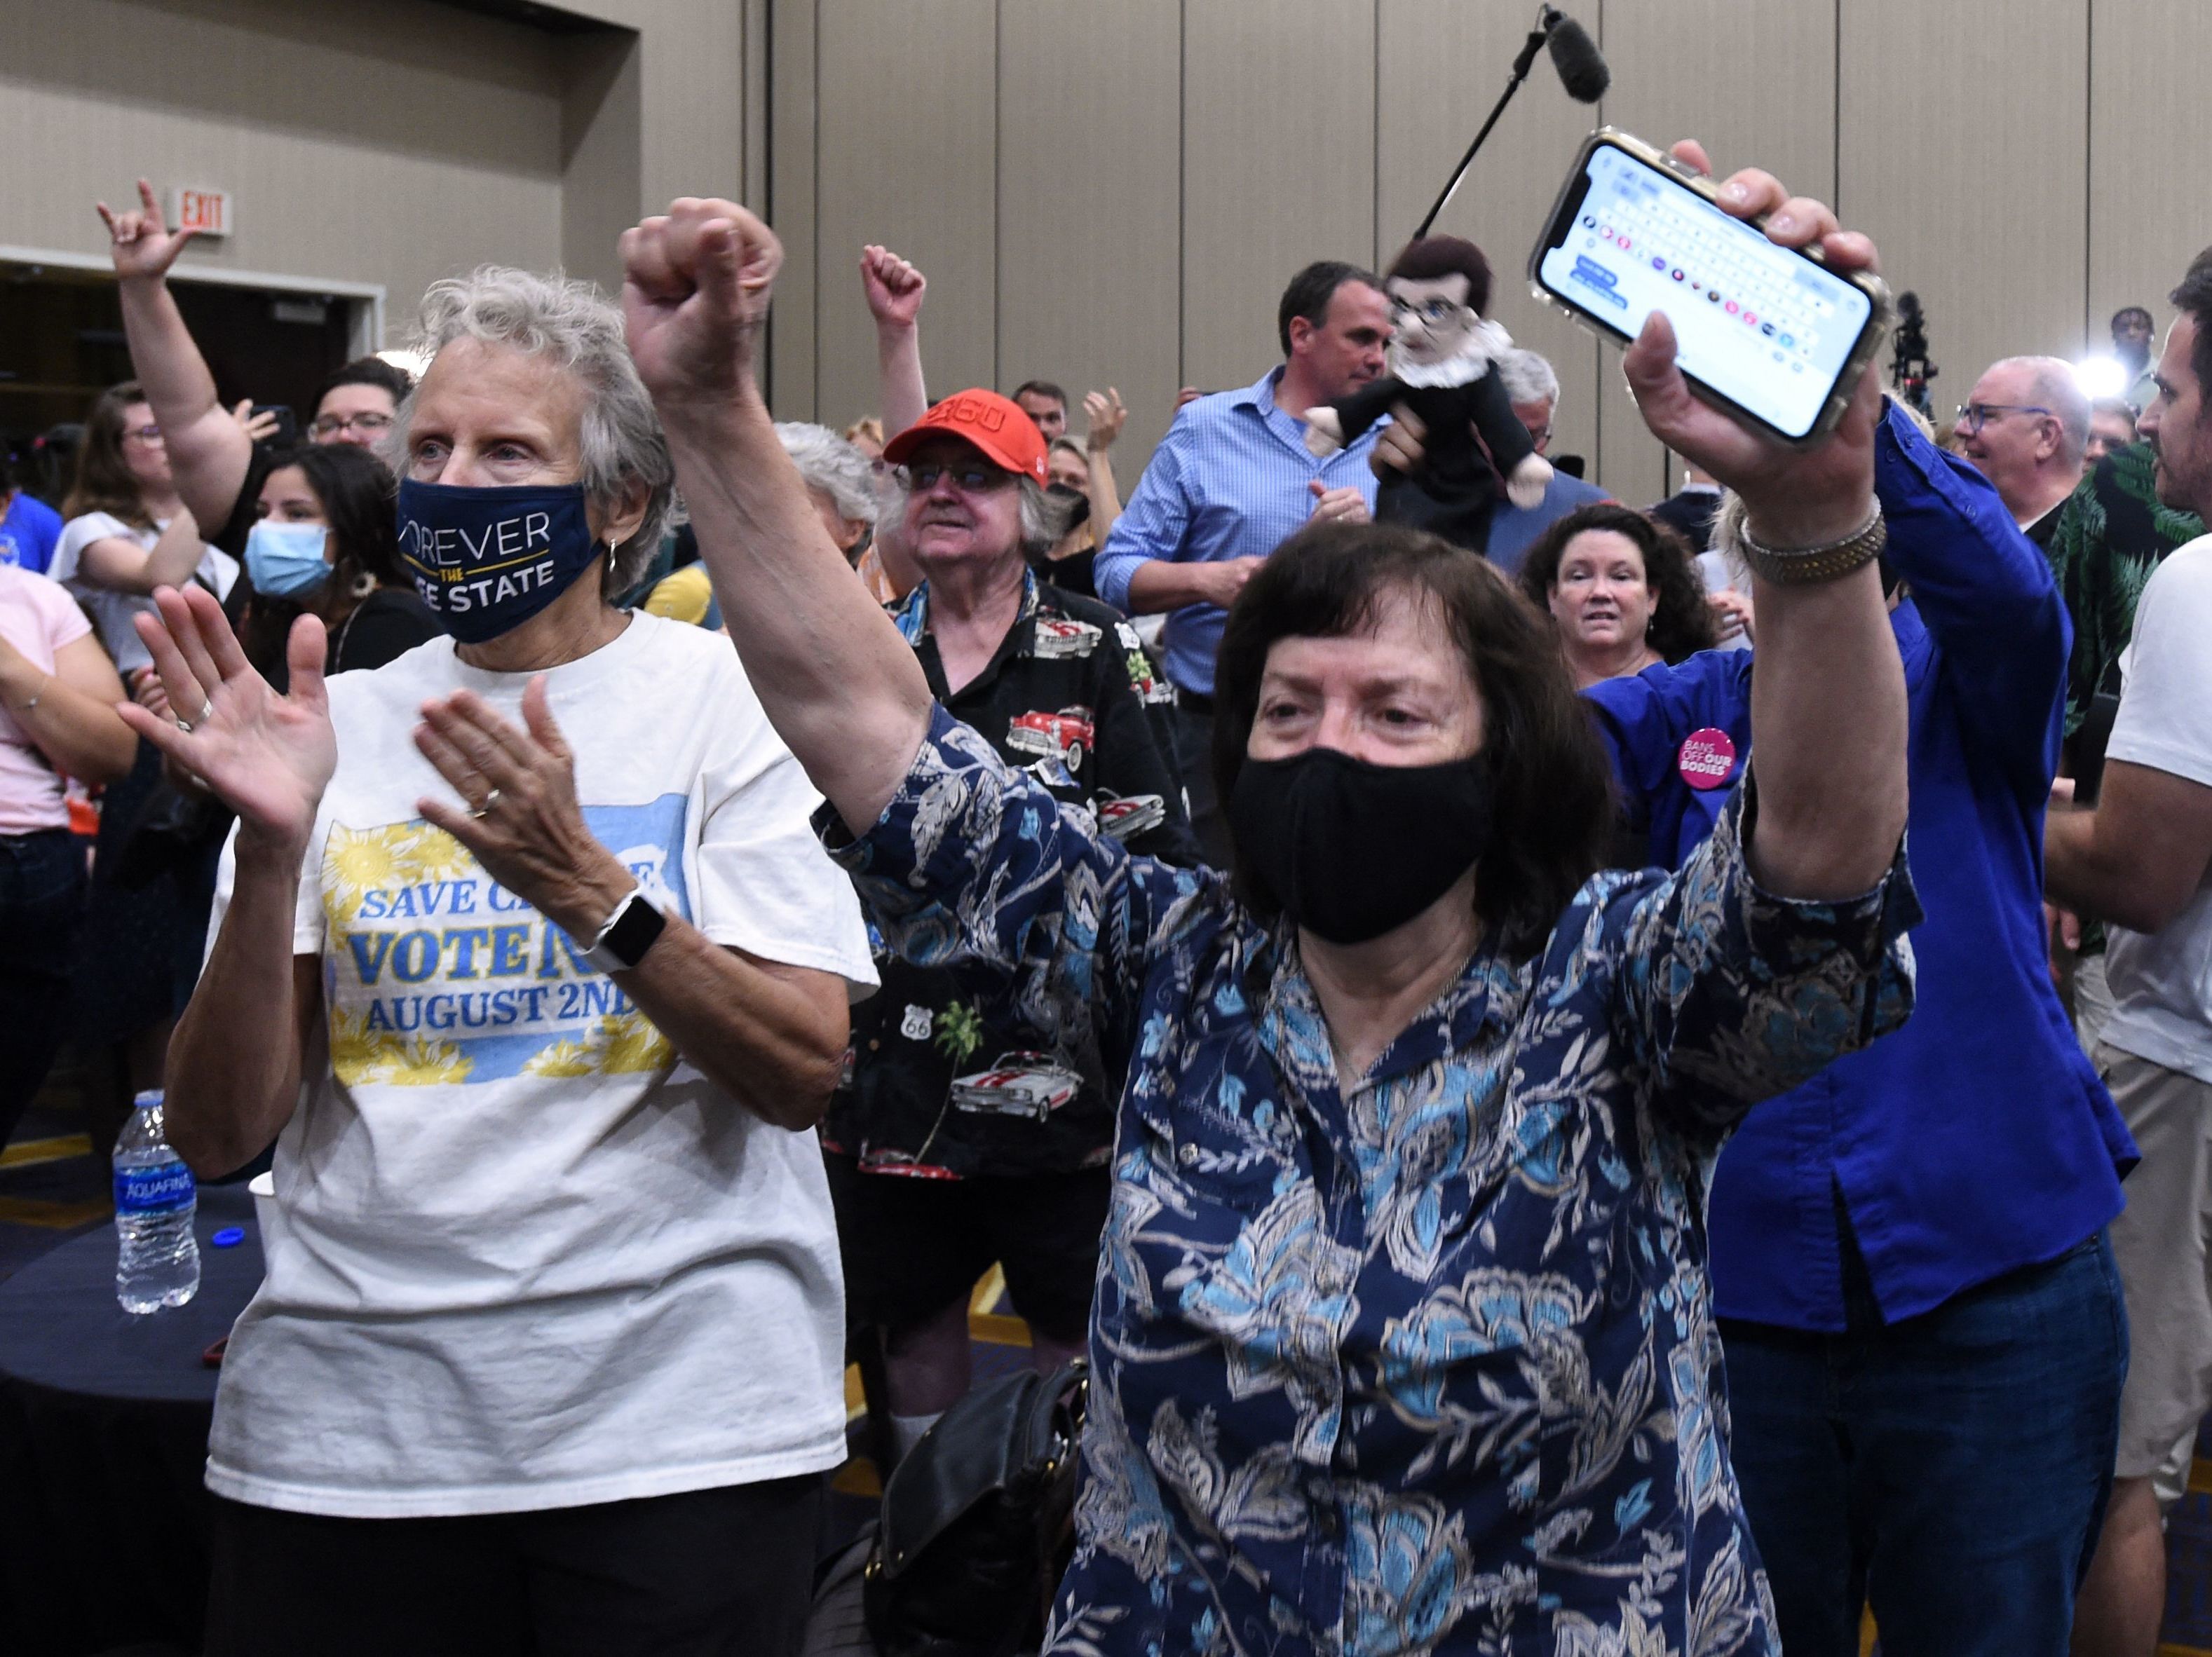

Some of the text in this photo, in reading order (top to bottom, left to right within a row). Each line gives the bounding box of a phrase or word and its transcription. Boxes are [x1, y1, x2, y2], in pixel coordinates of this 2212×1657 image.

[183, 191, 223, 229] EXIT
[398, 511, 551, 566] OREVER
[439, 567, 465, 583] THE
[448, 559, 555, 613] STATE
[1680, 760, 1725, 777] BODIES
[1704, 753, 1732, 768] OUR
[358, 879, 477, 920] SAVE
[348, 923, 531, 987] VOTE
[366, 986, 549, 1032] AUGUST
[126, 1173, 191, 1200] AQUAFINA
